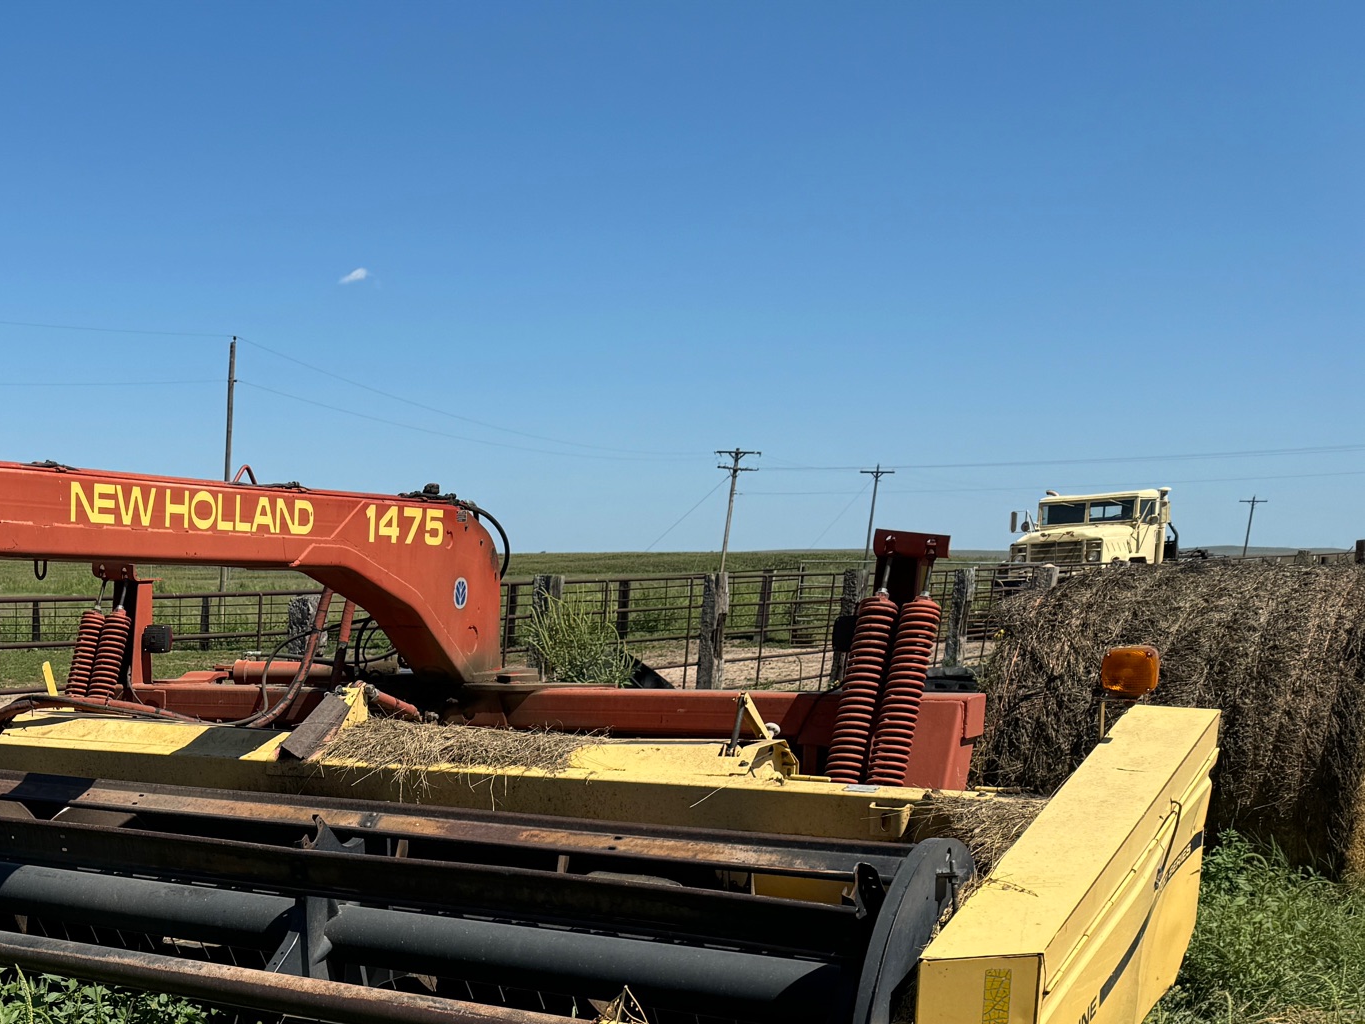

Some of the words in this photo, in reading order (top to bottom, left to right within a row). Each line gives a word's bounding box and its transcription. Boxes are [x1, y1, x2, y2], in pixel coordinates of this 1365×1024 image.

[70, 481, 156, 526] NEW
[165, 489, 314, 535] HOLLAND
[365, 504, 444, 546] 1475
